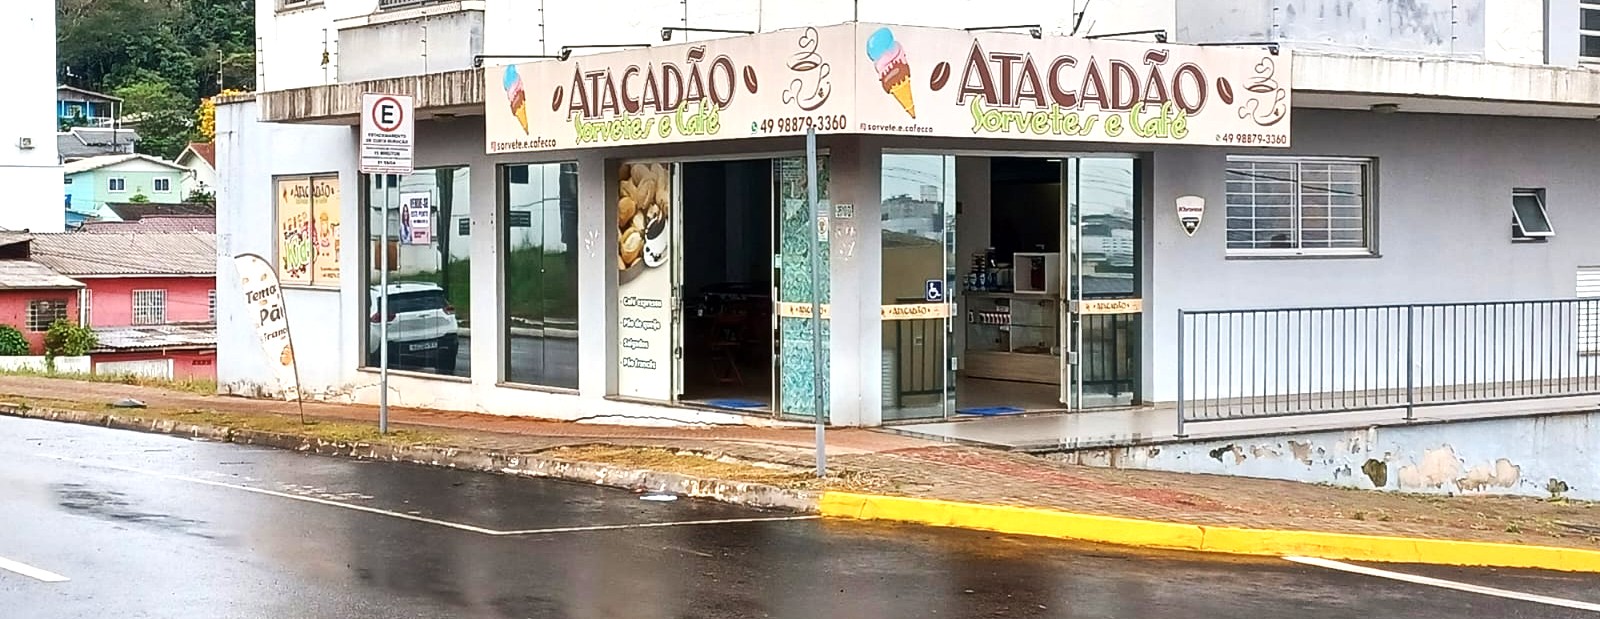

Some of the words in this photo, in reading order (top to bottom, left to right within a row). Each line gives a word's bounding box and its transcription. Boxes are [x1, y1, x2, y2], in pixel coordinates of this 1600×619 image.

[567, 46, 736, 121] ATACADÃO
[956, 38, 1208, 115] ATACADÃO
[381, 104, 394, 124] E
[574, 109, 655, 144] Sorvetes
[658, 114, 673, 139] e
[675, 96, 721, 137] Café
[760, 119, 774, 133] 49
[777, 115, 847, 132] 98879-3360
[970, 94, 1099, 136] Sorvetes
[1105, 111, 1124, 135] e
[1128, 101, 1190, 140] Café
[1222, 133, 1234, 143] 49
[1236, 134, 1287, 144] 98879-3360
